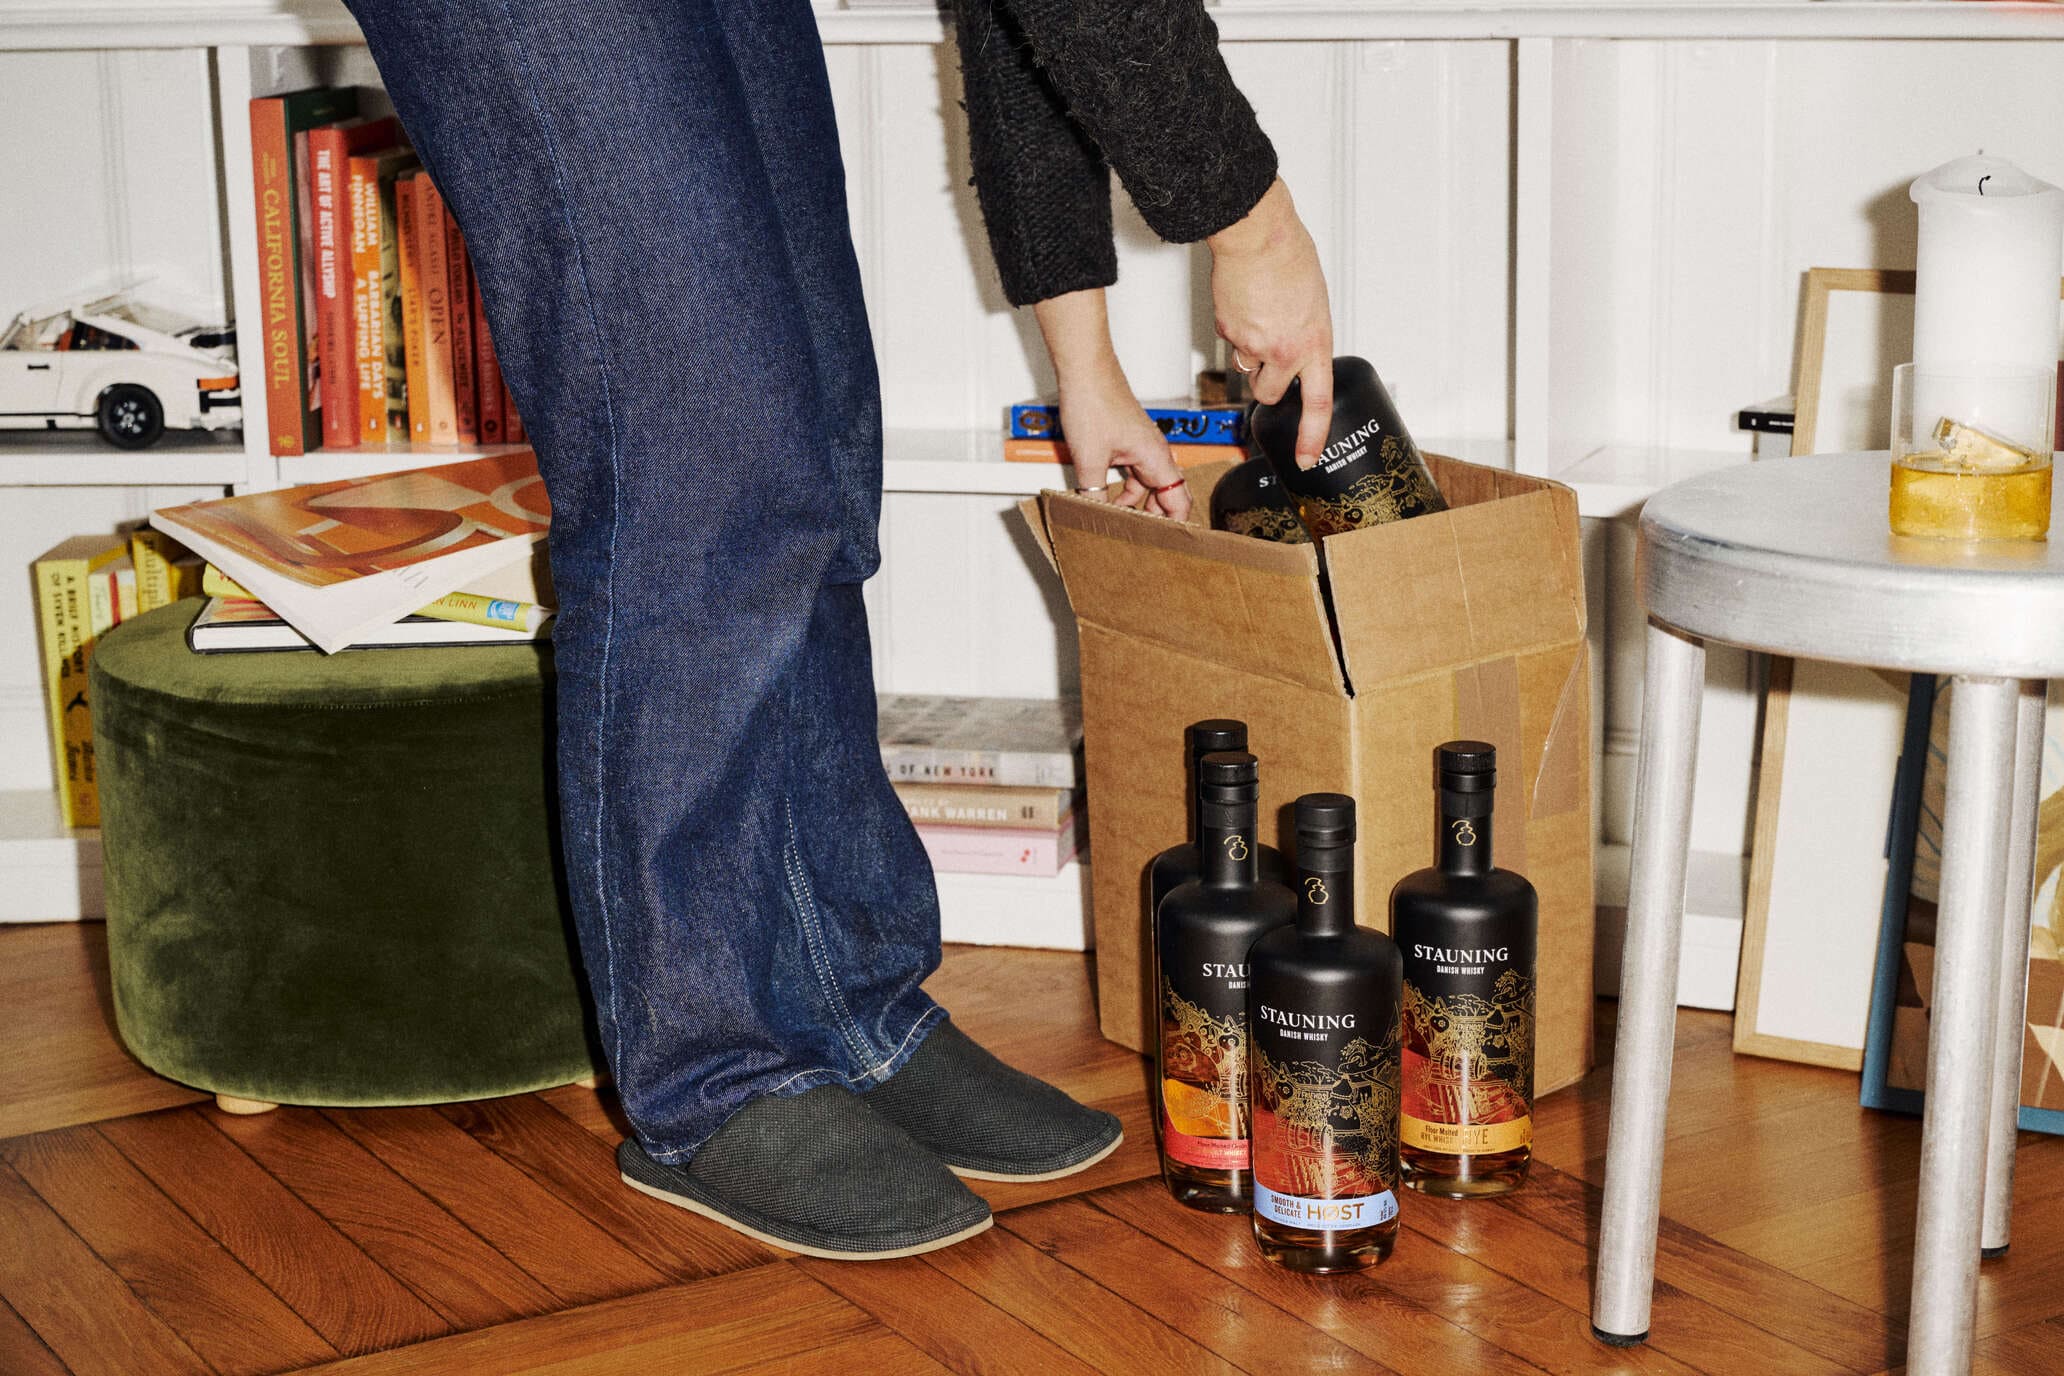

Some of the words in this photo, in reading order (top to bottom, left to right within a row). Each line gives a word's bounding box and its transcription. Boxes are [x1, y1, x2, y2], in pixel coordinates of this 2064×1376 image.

[317, 149, 331, 171] THE
[318, 171, 332, 193] ART
[319, 194, 333, 209] OF
[352, 174, 366, 254] FINNEGAN
[365, 181, 378, 246] WILLIAM
[320, 210, 335, 247] ACTIVE
[262, 189, 286, 325] CALIFORNIA
[321, 249, 337, 299] ALLYSHIP
[356, 278, 367, 289] A
[368, 270, 383, 358] BARBARIAN
[429, 287, 446, 345] OPEN
[357, 293, 371, 359] SURFING
[271, 329, 290, 390] SOUL
[360, 362, 371, 390] LIFE
[372, 360, 384, 399] DAYS
[1301, 419, 1380, 472] AUNING
[448, 599, 478, 610] LINN
[900, 764, 915, 774] OF
[924, 765, 951, 776] NEW
[960, 766, 995, 778] YORK
[944, 807, 1008, 822] WARREN
[1414, 944, 1509, 964] STAUNING
[1202, 962, 1250, 978] STAU
[1436, 965, 1459, 975] DANISH
[1460, 967, 1485, 976] WHISKY
[1228, 981, 1249, 989] DANIS
[1260, 1005, 1356, 1030] STAUNING
[1279, 1028, 1302, 1040] DANISH
[1303, 1032, 1329, 1042] WHISKY
[1425, 1124, 1439, 1134] Floor
[1439, 1127, 1459, 1137] Malted
[1433, 1134, 1455, 1146] WHIS
[1271, 1194, 1295, 1210] SMOOTH
[1296, 1201, 1301, 1210] &
[1274, 1205, 1301, 1219] DELICATE
[1307, 1202, 1365, 1221] HØST
